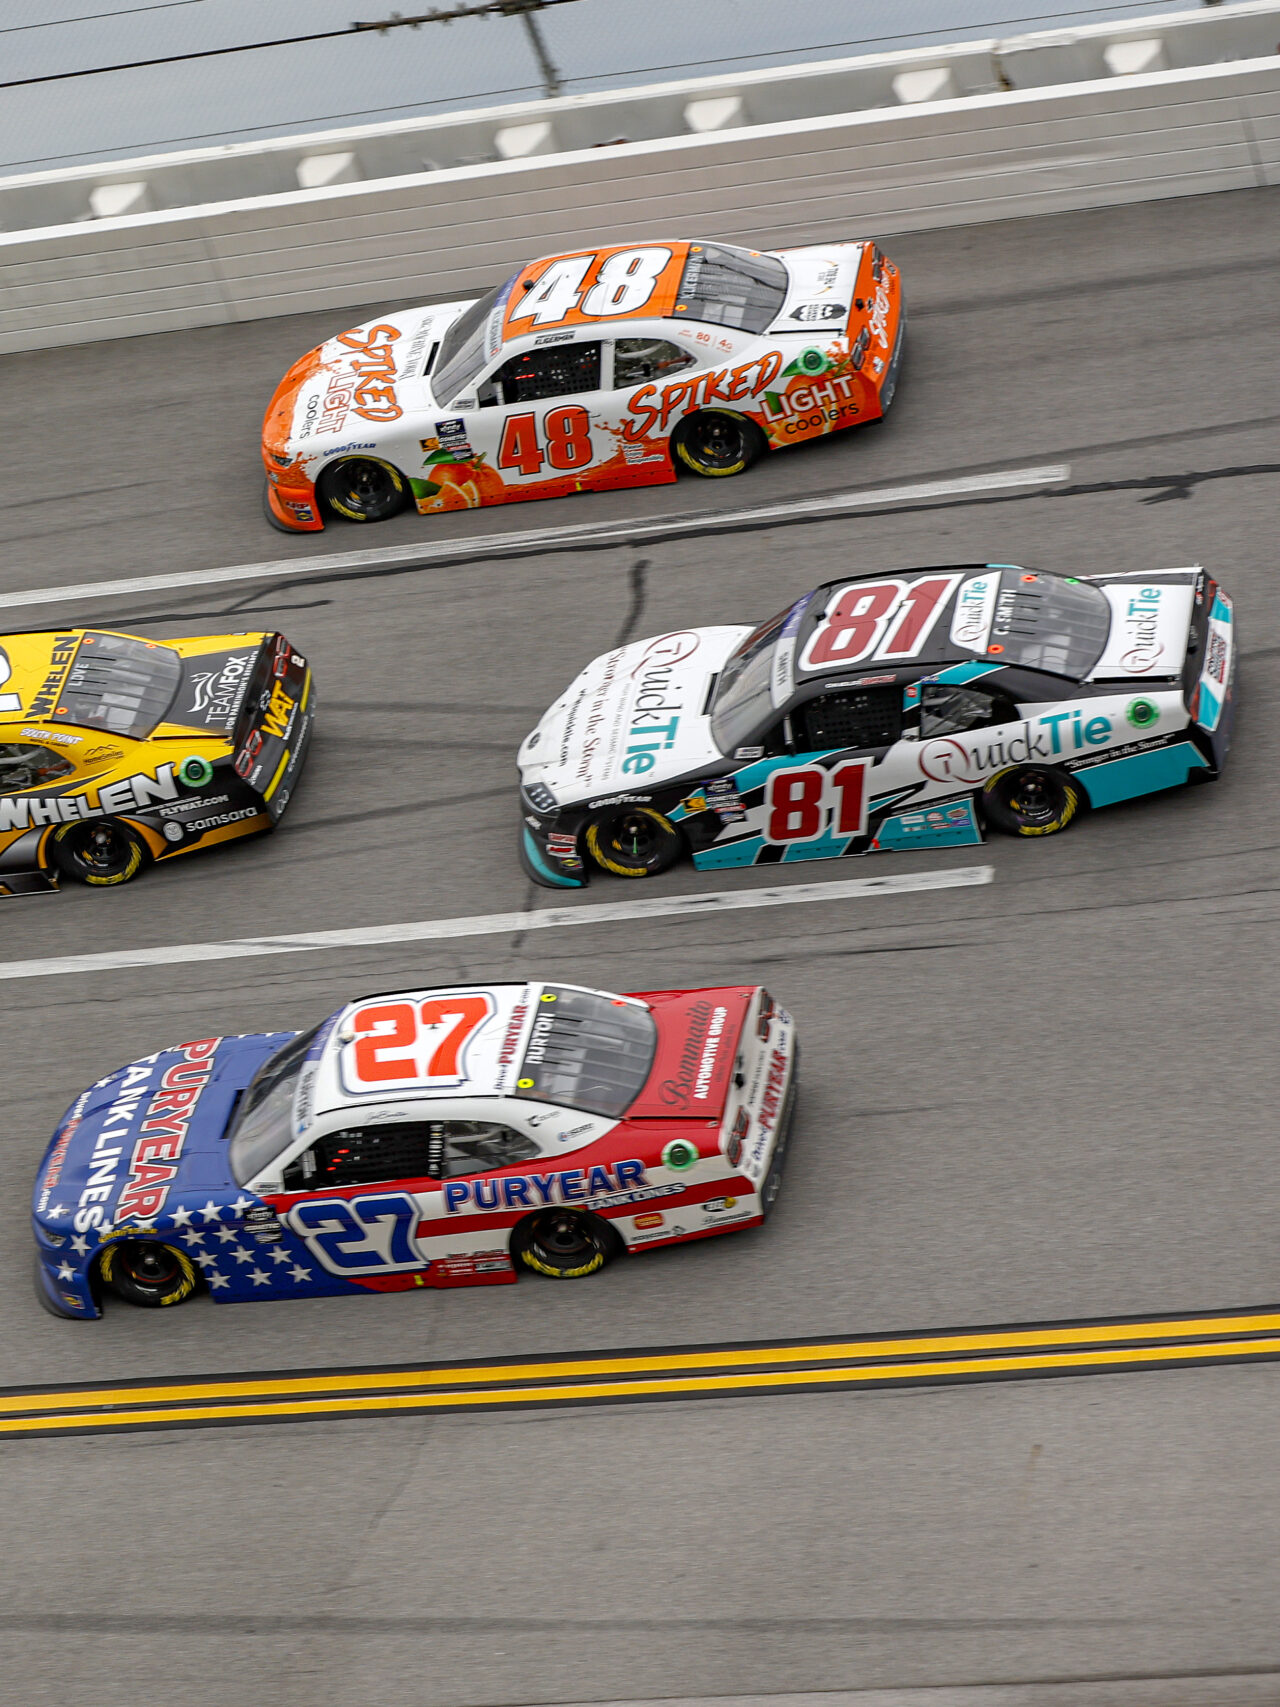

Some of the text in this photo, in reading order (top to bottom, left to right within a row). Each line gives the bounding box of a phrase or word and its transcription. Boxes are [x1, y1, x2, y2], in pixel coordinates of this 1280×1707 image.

[507, 246, 674, 327] 48
[316, 371, 358, 435] LIGHT
[336, 324, 404, 422] SPIKED
[622, 351, 783, 442] SPIKED
[759, 374, 855, 424] LIGHT
[300, 394, 320, 439] coolers
[323, 442, 376, 457] GOODYEAR
[497, 404, 594, 477] 48
[785, 402, 859, 434] coolers
[797, 572, 966, 672] 81
[954, 580, 989, 643] QuickTie
[1120, 587, 1164, 674] QuickTie
[24, 635, 81, 719] WHELEN
[68, 662, 89, 687] LOVE
[260, 679, 295, 739] WAT
[622, 631, 701, 776] QuickTie
[918, 709, 1113, 783] QuickTie
[160, 795, 230, 817] FLYWAT.COM
[186, 806, 259, 832] samsara
[762, 756, 875, 846] 81
[350, 994, 492, 1086] 27
[525, 1012, 555, 1065] BURTON
[658, 999, 714, 1111] Bommarito
[692, 1005, 728, 1100] AUTOMOTIVE GROUP
[73, 1051, 162, 1234] TANK LINES
[113, 1036, 223, 1226] PURYEAR
[442, 1158, 652, 1215] PURYEAR
[287, 1189, 432, 1280] 27
